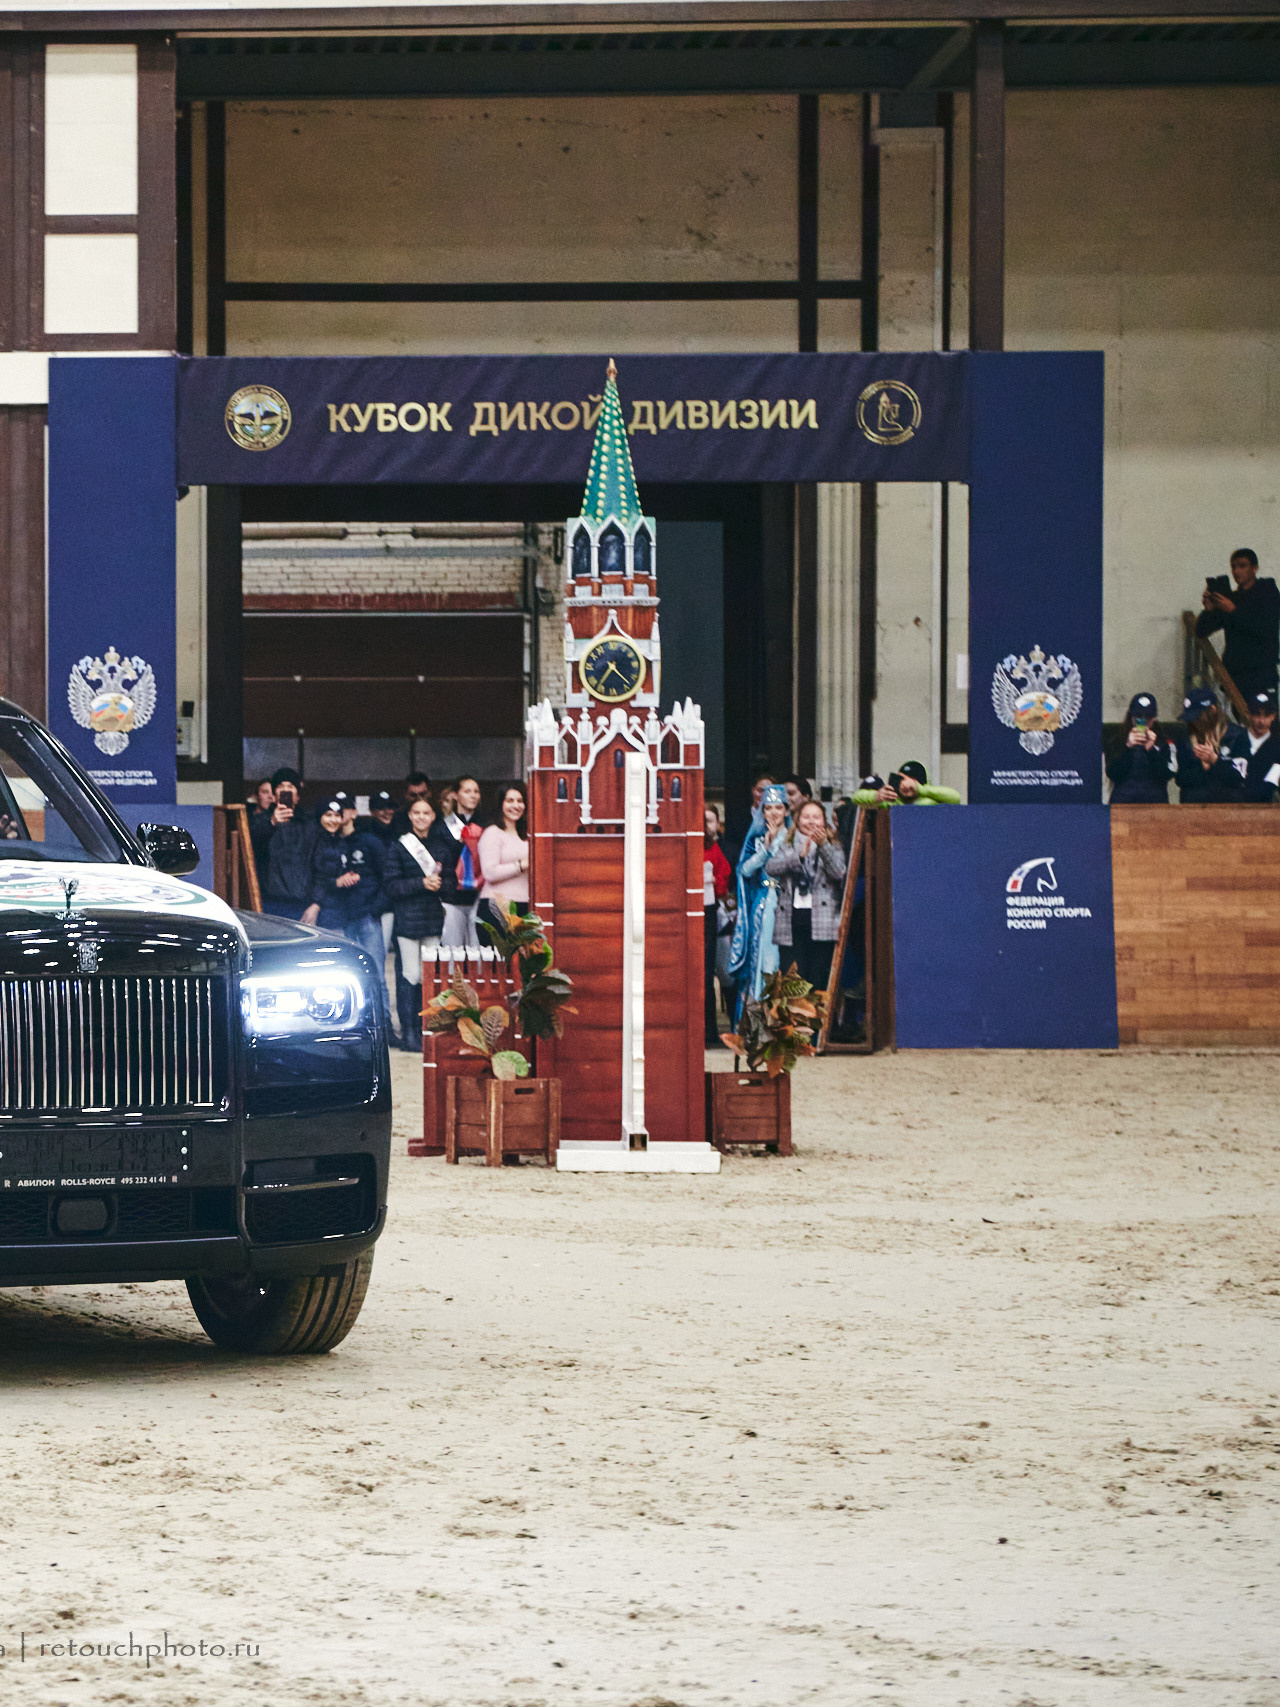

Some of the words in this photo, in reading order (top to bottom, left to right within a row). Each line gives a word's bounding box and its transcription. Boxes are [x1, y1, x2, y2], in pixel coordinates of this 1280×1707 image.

[327, 401, 453, 433] КУБОК
[468, 393, 604, 437] ДИКОЙ
[627, 399, 819, 436] ДИВИЗИИ
[1006, 896, 1065, 907] ФЕДЕРАЦИЯ
[1006, 907, 1053, 918] КОННОГО
[1053, 907, 1092, 918] СПОРТА
[1006, 919, 1047, 930] РОССИИ
[17, 1179, 56, 1187] АВИЛОН
[60, 1177, 116, 1187] ROLLS-ROYCE
[120, 1177, 134, 1185] 495
[135, 1177, 148, 1185] 232
